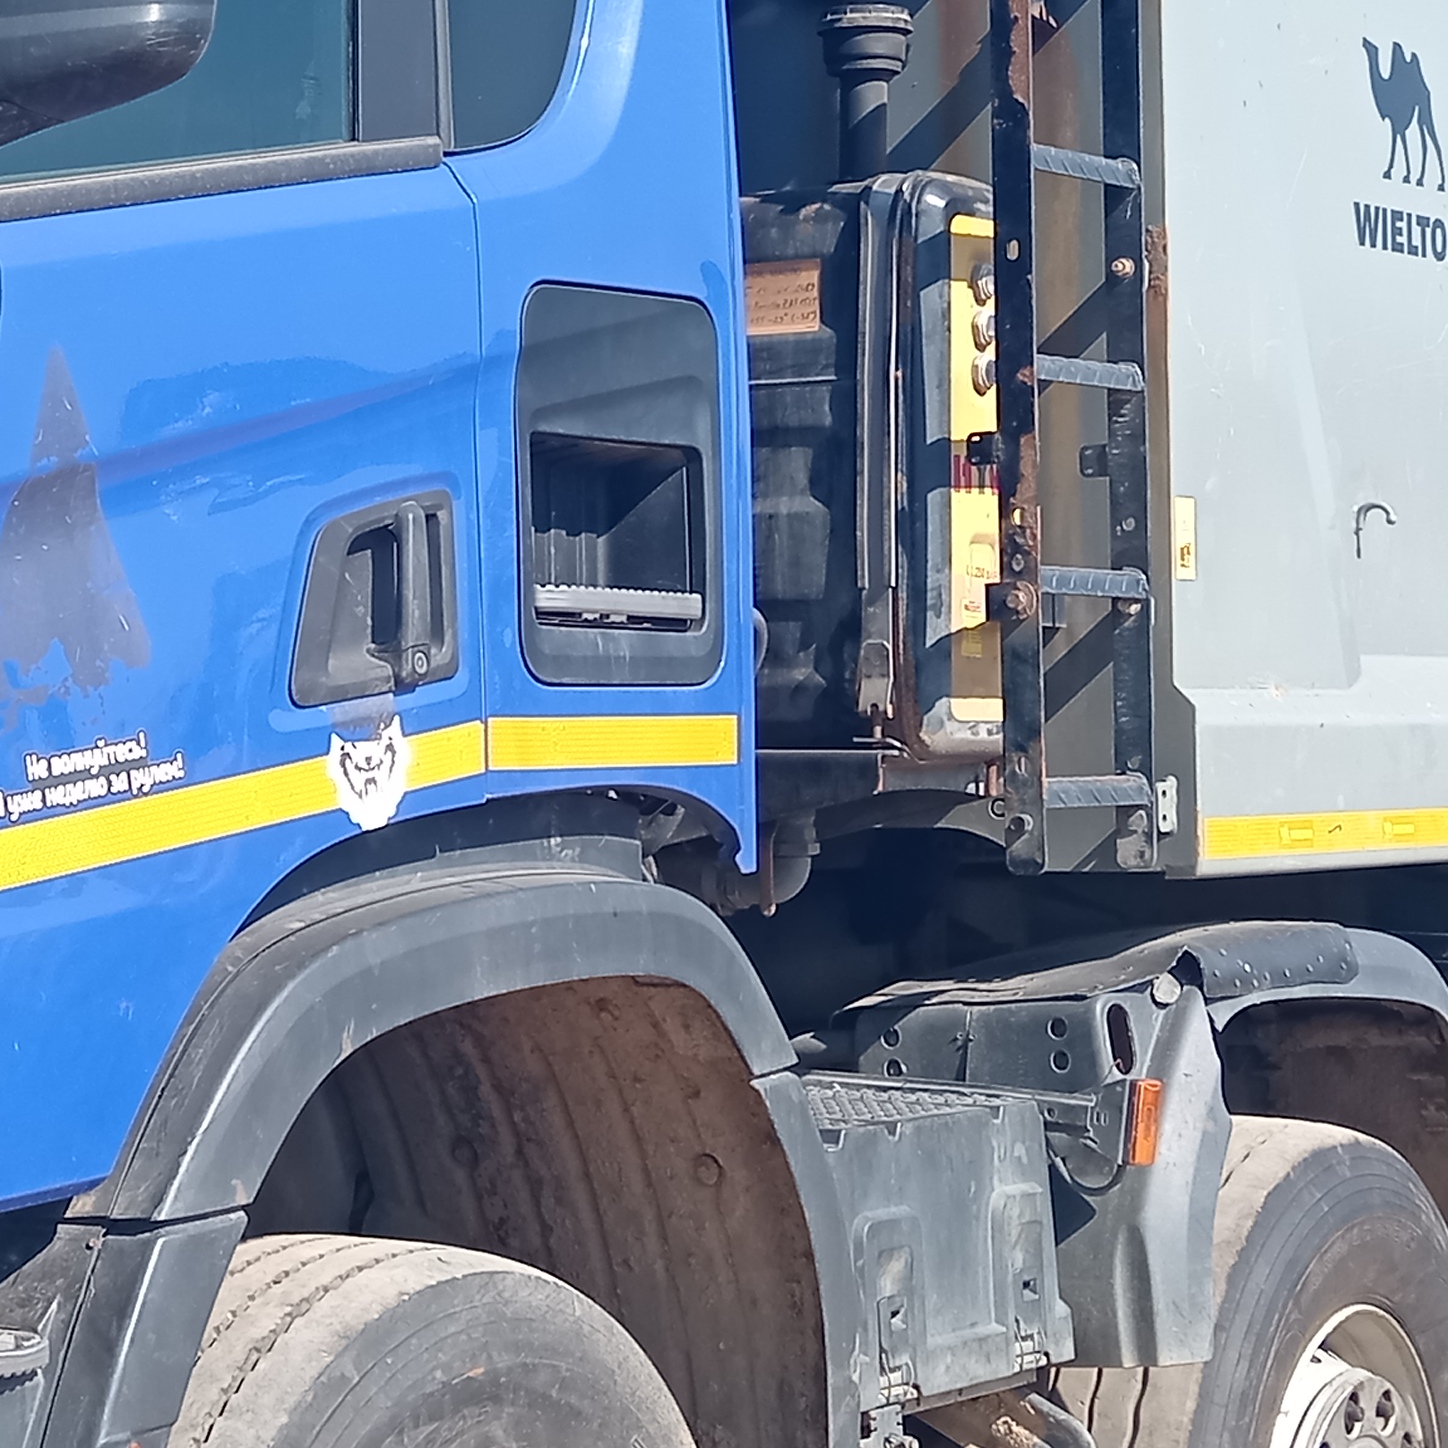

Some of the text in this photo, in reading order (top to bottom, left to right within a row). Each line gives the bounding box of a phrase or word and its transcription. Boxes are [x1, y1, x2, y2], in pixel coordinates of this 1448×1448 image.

[25, 729, 147, 782] Не волнуйтесь!
[6, 788, 44, 822] уже
[44, 776, 108, 808] неделю
[109, 771, 130, 795] за
